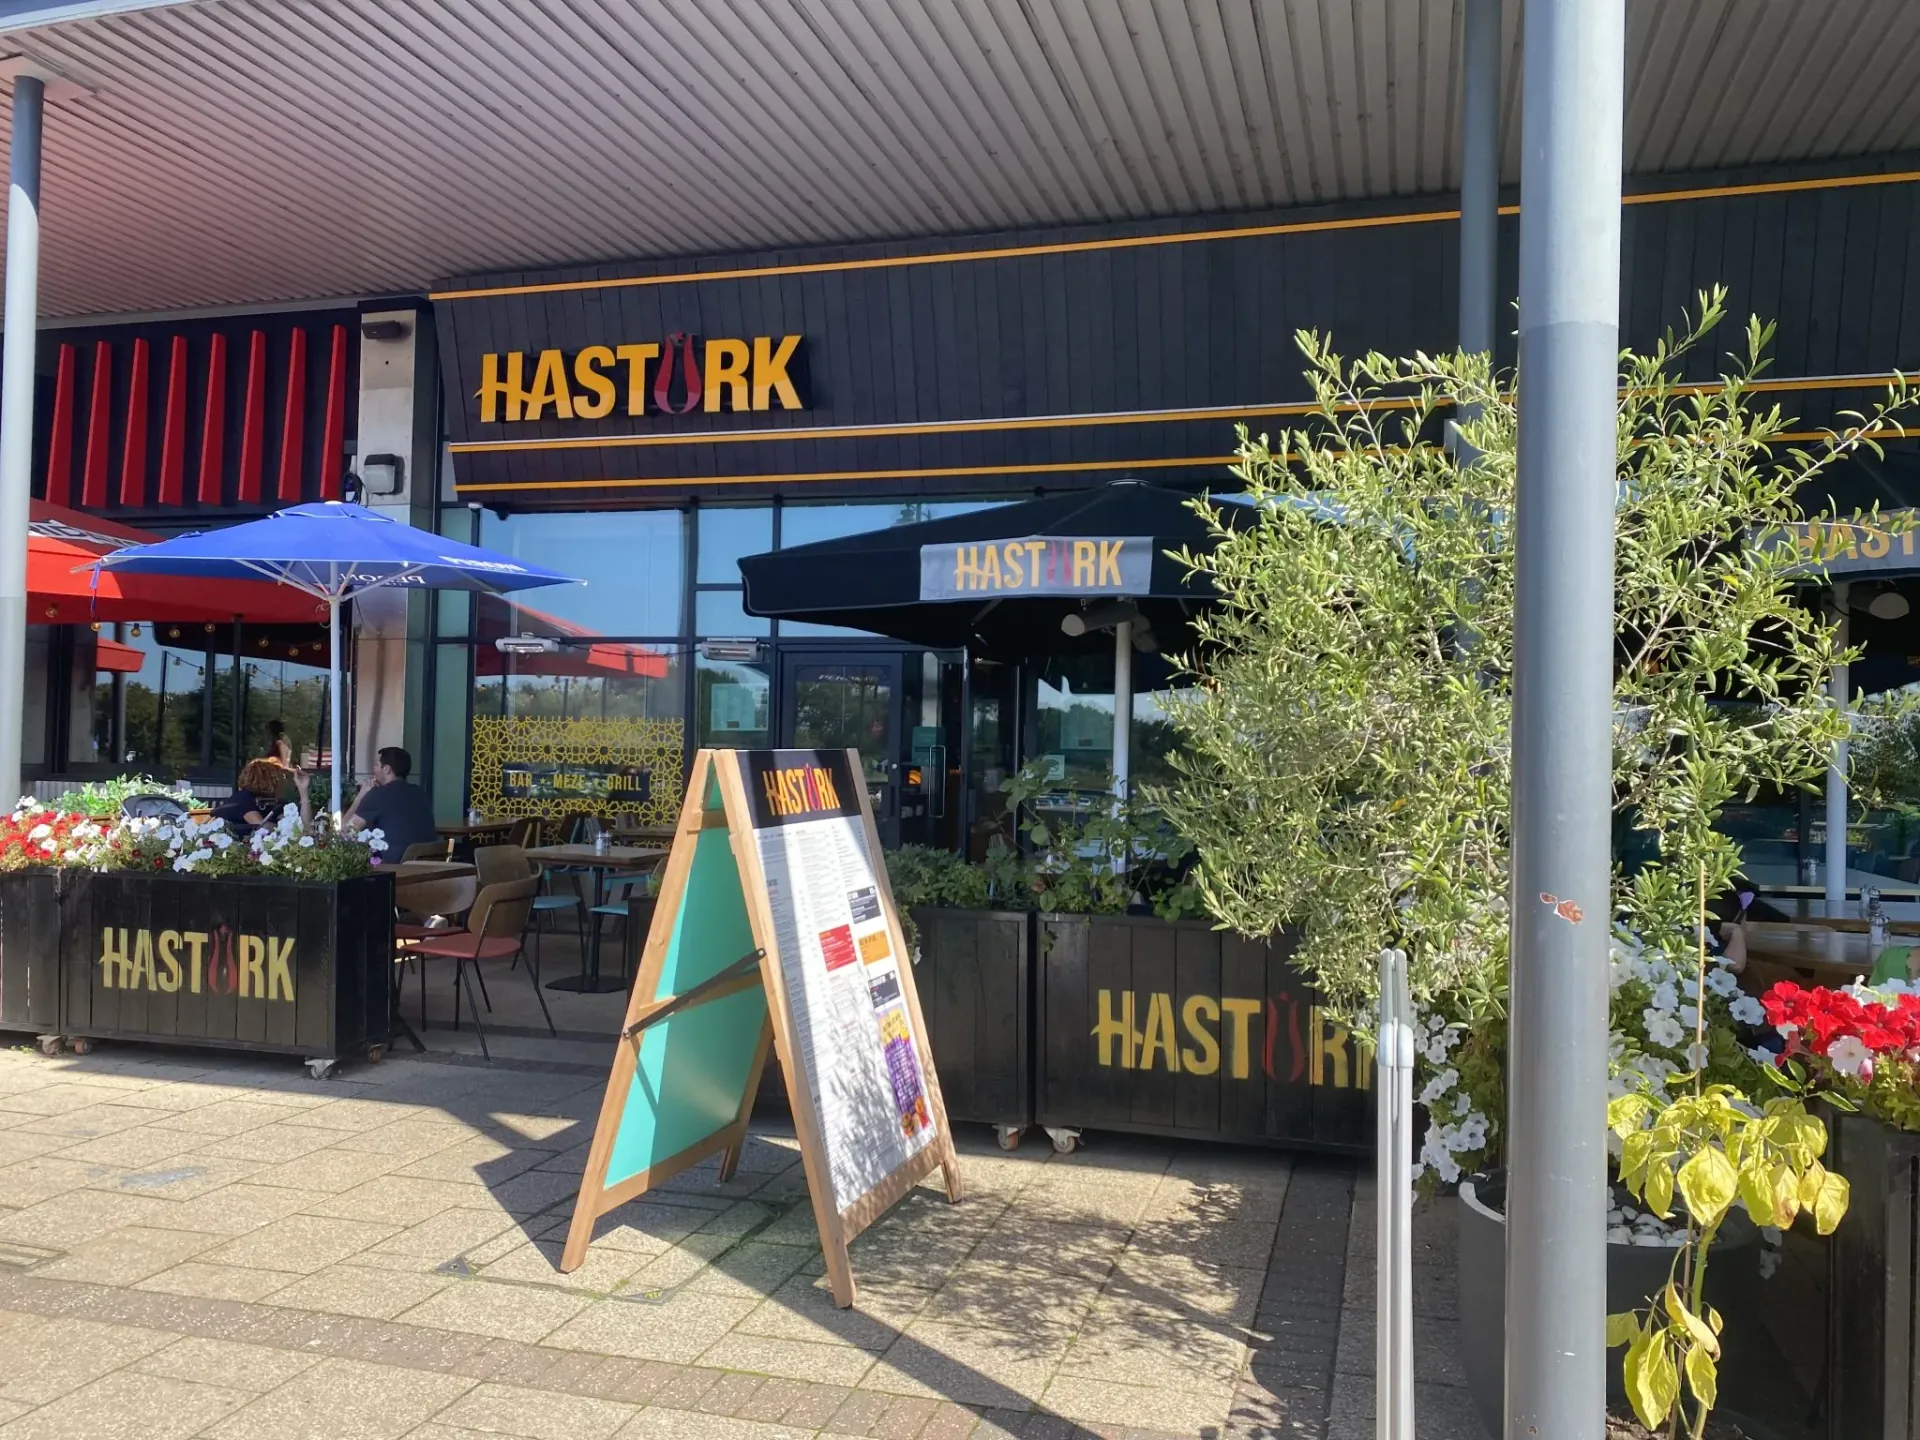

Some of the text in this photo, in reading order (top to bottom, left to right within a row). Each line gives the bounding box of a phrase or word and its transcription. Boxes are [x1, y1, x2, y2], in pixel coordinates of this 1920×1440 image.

[509, 772, 642, 791] BAR MEZE GRILL
